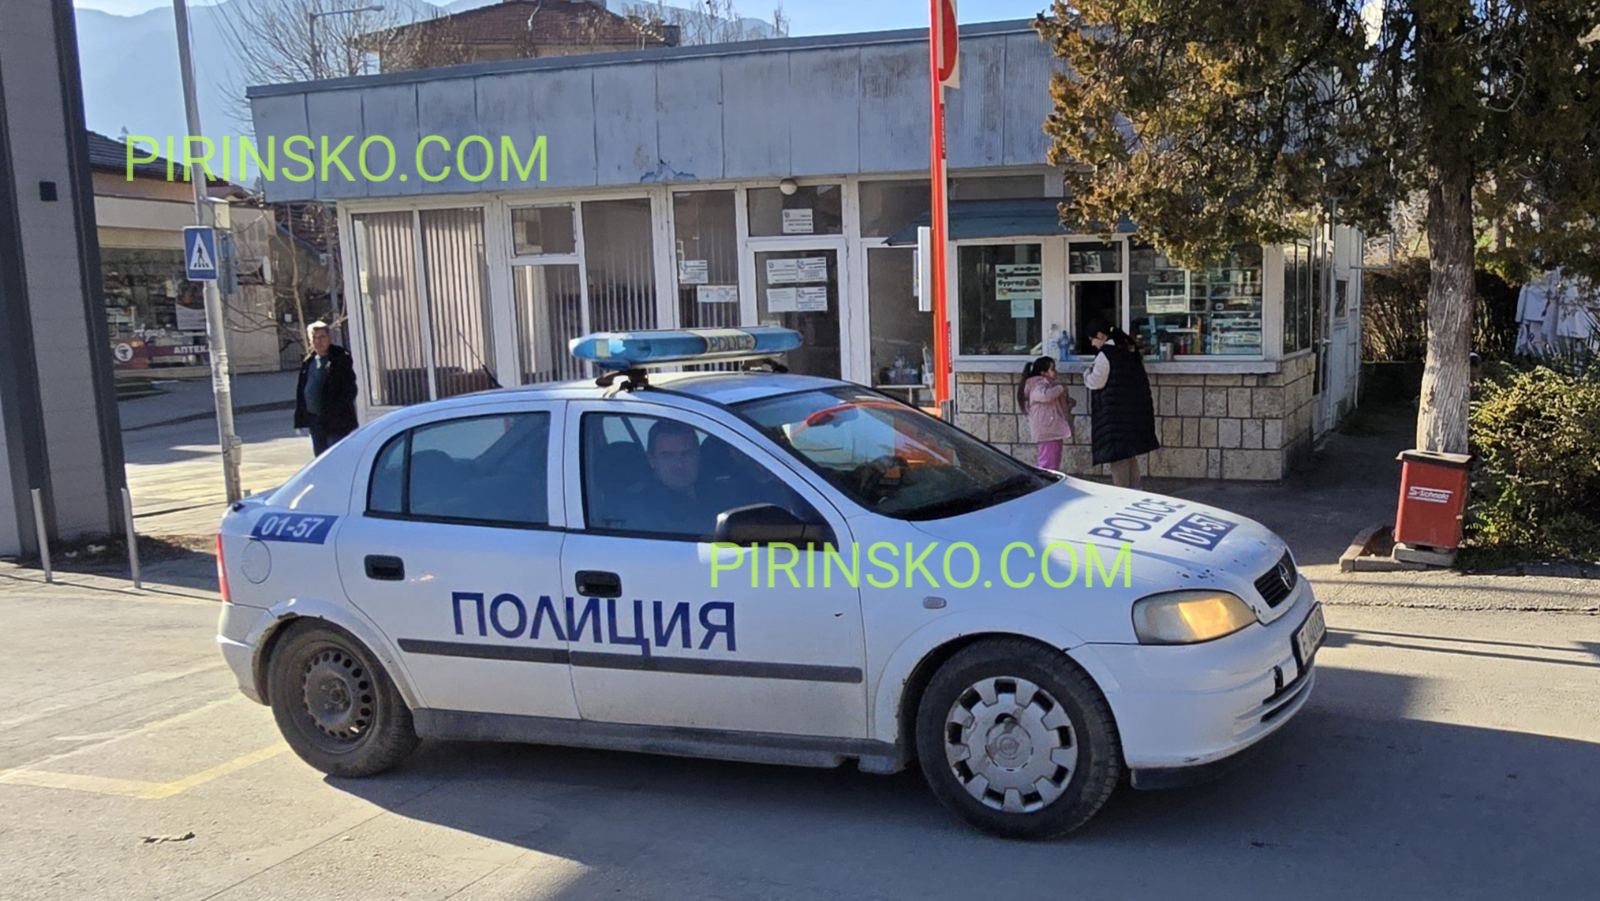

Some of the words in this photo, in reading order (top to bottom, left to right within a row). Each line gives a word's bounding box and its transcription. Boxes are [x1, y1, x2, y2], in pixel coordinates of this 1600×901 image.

[174, 345, 209, 354] АПТЕК
[709, 335, 752, 351] POLICE
[261, 516, 325, 538] 01-57
[1088, 499, 1187, 543] POLICE
[452, 592, 737, 657] ПОЛИЦИЯ
